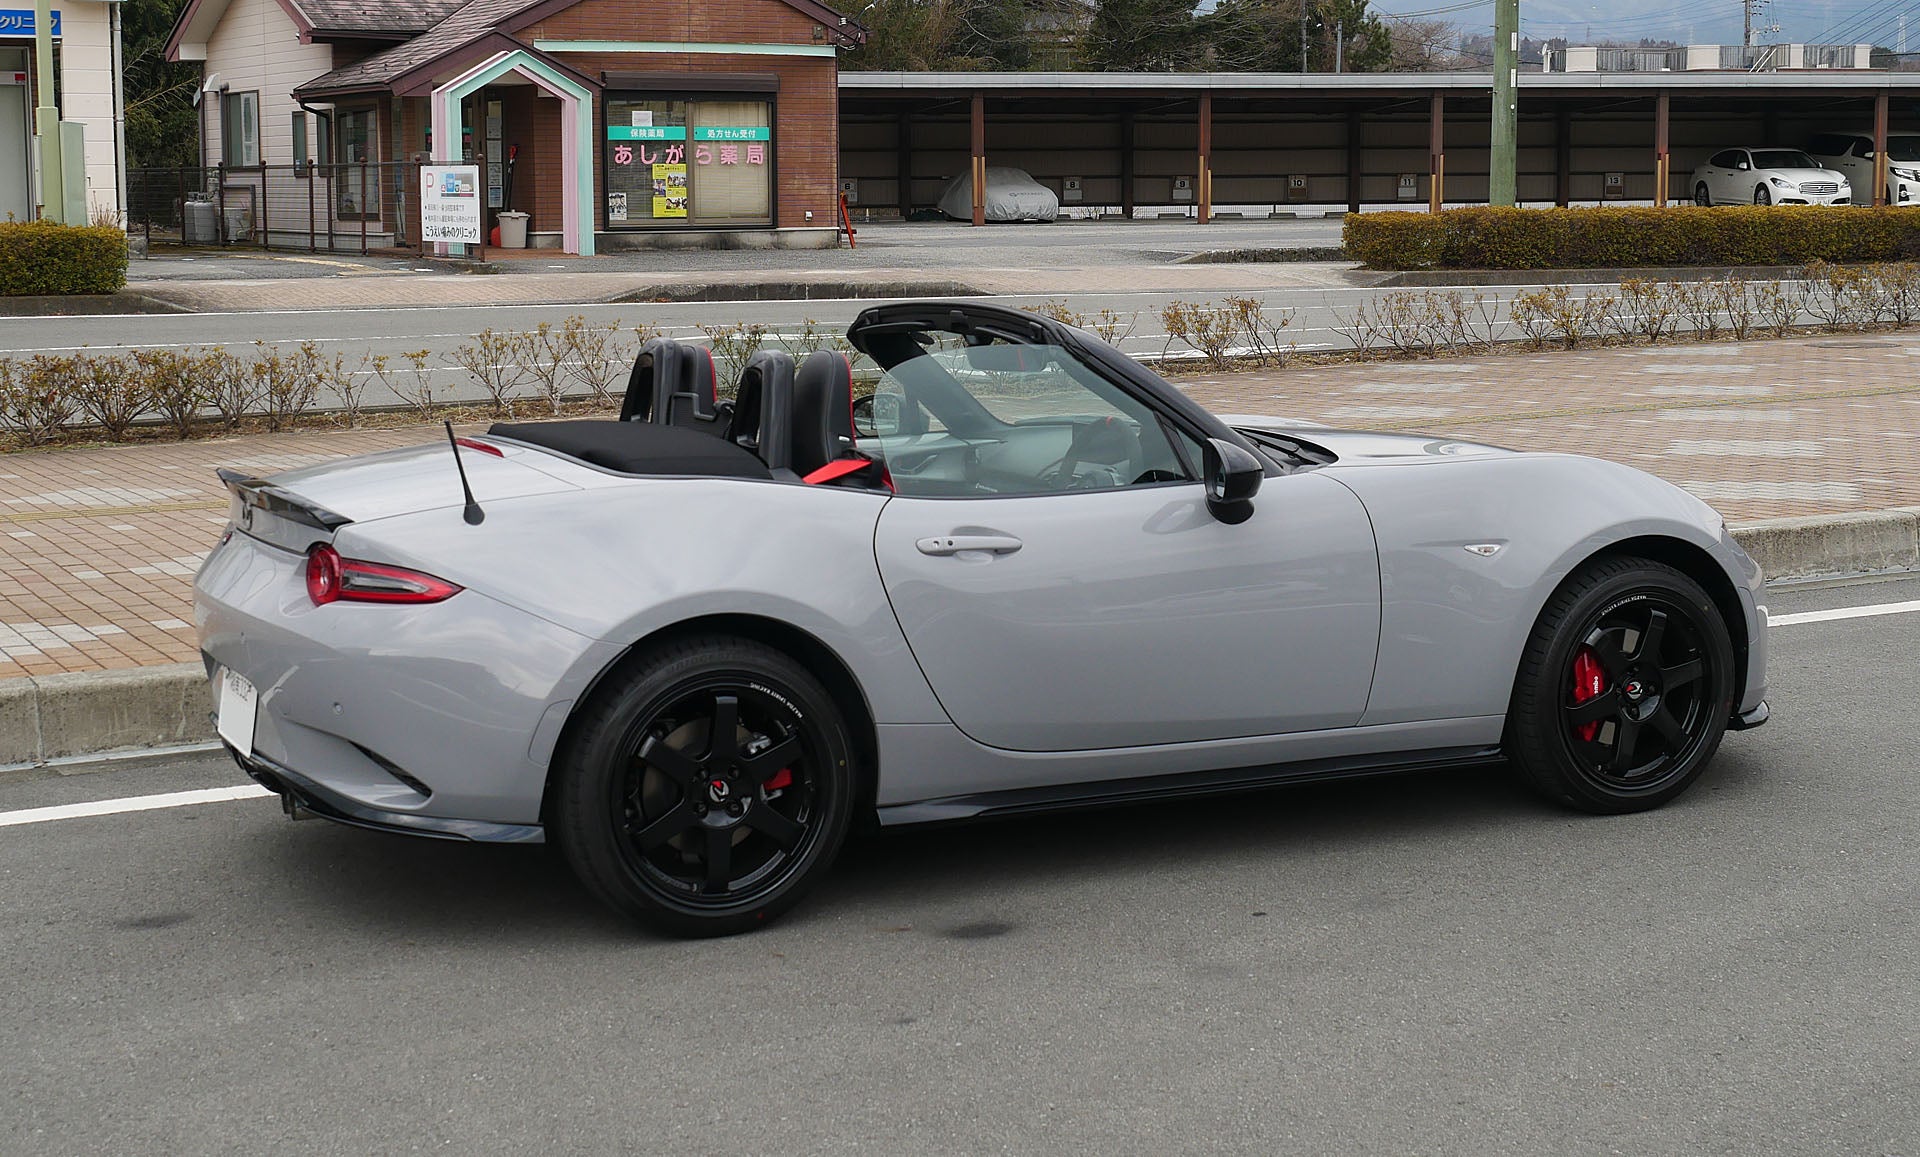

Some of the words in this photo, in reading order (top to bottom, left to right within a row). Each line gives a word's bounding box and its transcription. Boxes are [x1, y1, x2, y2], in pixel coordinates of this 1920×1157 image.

[0, 16, 58, 29] クリニク
[630, 128, 665, 138] 保険薬局
[707, 129, 756, 139] 処方せん受付
[614, 144, 764, 165] あしがら薬局
[425, 172, 434, 198] P
[1403, 178, 1412, 186] 11
